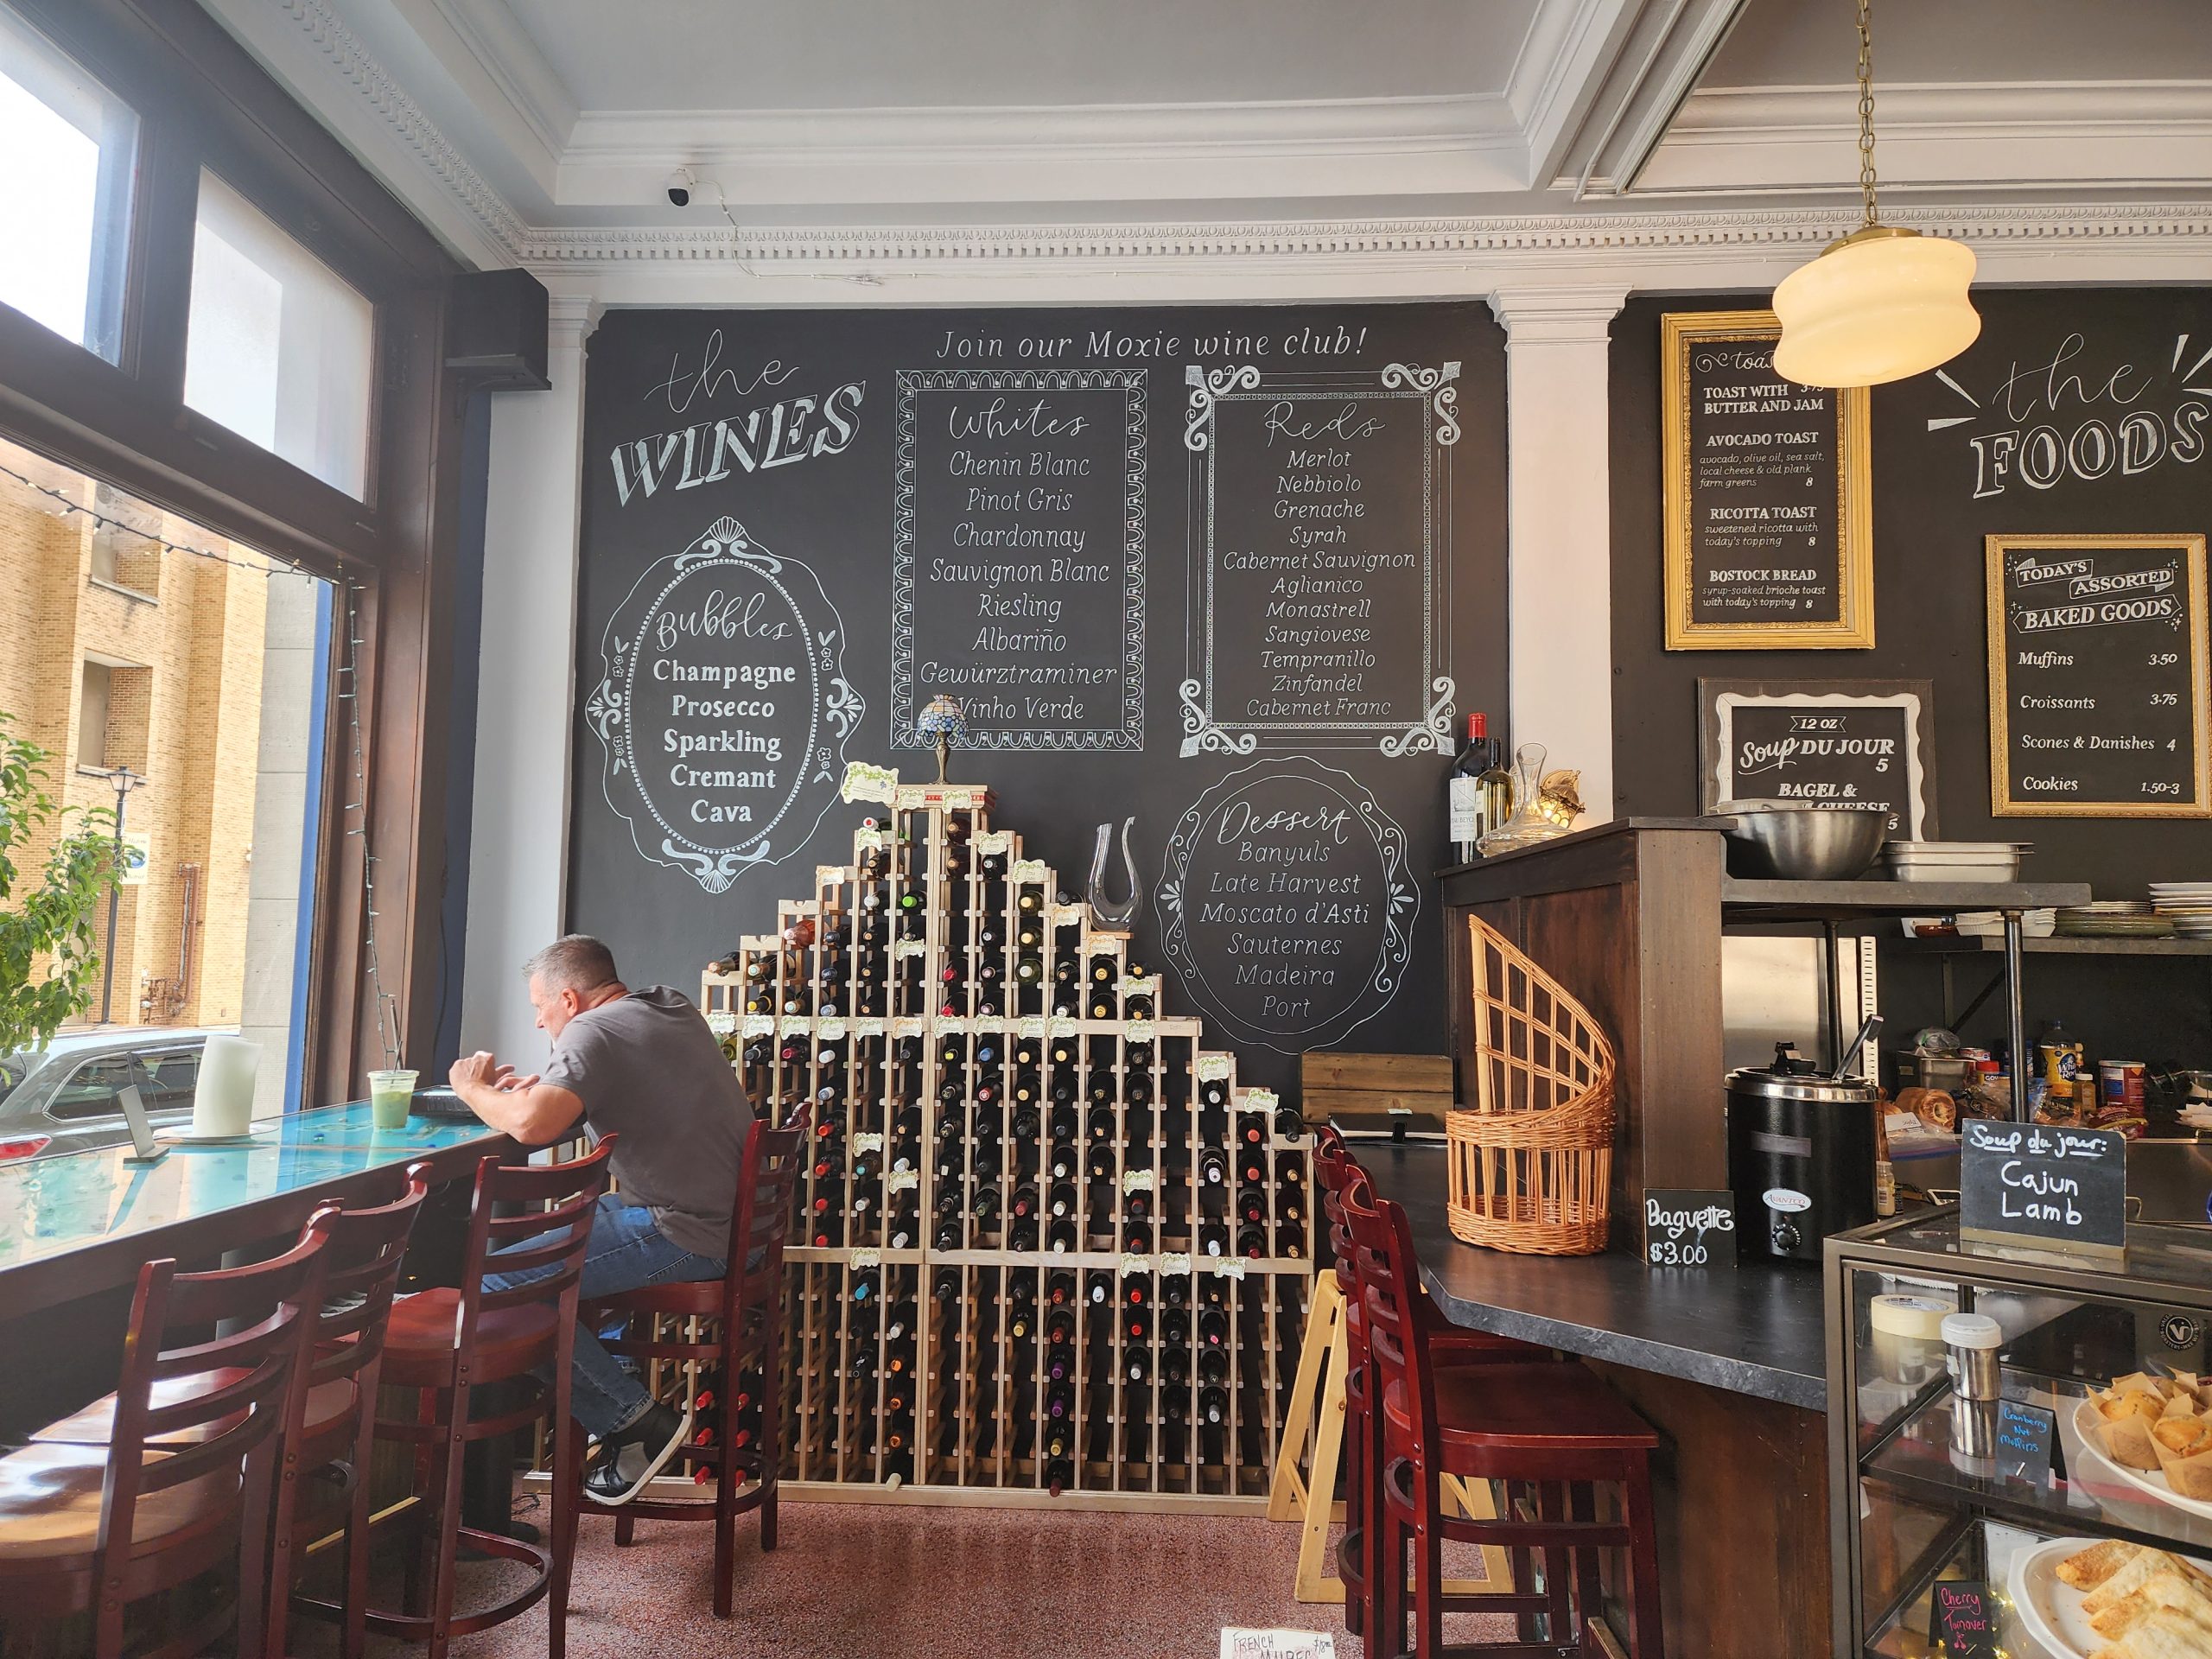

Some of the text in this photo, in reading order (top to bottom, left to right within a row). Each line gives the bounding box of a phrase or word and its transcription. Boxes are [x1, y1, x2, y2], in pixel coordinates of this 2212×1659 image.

[937, 326, 1368, 358] Join our Moxie wine club!
[644, 329, 799, 413] the
[1992, 333, 2152, 423] the
[1703, 386, 1747, 399] TOAST
[1750, 385, 1789, 397] WITH
[1704, 398, 1824, 415] BUTTER AND JAM
[950, 397, 1090, 440] Whites
[1263, 401, 1386, 448] Reds
[611, 379, 866, 507] WINES
[1706, 432, 1819, 447] AVOCADO TOAST
[1970, 401, 2209, 499] FOODS
[950, 450, 1090, 476] Chenin Blanc
[1287, 448, 1351, 469] Merlot
[1700, 454, 1742, 465] avocado,
[1744, 453, 1767, 463] olive
[1769, 453, 1783, 463] oil,
[1804, 451, 1825, 462] salt,
[1700, 463, 1812, 476] local cheese & old plank
[1276, 474, 1362, 494] Nebbiolo
[1698, 477, 1814, 489] farm greens 8
[966, 486, 1073, 512] Pinot Gris
[1274, 499, 1365, 519] Grenache
[1709, 506, 1816, 519] RICOTTA TOAST
[953, 522, 1086, 553] Chardonnay
[1289, 525, 1347, 548] Syrah
[1705, 522, 1819, 534] sweetened ricotta with
[1705, 536, 1815, 548] today's topping 8
[930, 557, 1109, 588] Sauvignon Blanc
[1224, 550, 1416, 573] Cabernet Sauvignon
[2019, 562, 2088, 582] TODAY'S
[1270, 576, 1363, 598] Aglianico
[1709, 569, 1817, 582] BOSTOCK BREAD
[2074, 570, 2171, 595] ASSORTED
[1702, 585, 1826, 596] syrup-soaked brioche toast
[977, 593, 1062, 623] Riesling
[1265, 599, 1371, 619] Monastrell
[1702, 597, 1814, 609] with today's topping 8
[2024, 599, 2172, 630] BAKED GOODS
[656, 589, 792, 652] Bubbles
[971, 626, 1066, 652] Albariño
[1265, 626, 1371, 646] Sangiovese
[1261, 650, 1376, 671] Tempranillo
[2018, 652, 2178, 669] Muffins 3.50
[653, 659, 796, 690] Champagne
[920, 661, 1117, 684] Gewürztraminer
[1272, 673, 1363, 696] Zinfandel
[671, 695, 775, 717] Prosecco
[957, 696, 1084, 720] Vinho Verde
[1247, 698, 1391, 717] Cabernet Franc
[2020, 695, 2095, 709] Croissants
[1800, 718, 1838, 729] 12 OZ
[664, 728, 782, 761] Sparkling
[1739, 737, 1895, 770] Soup DU JOUR
[2022, 734, 2176, 752] Scones & Danishes 4
[671, 764, 777, 789] Cremant
[1875, 758, 1889, 772] 5
[1777, 783, 1859, 798] BAGEL &
[2023, 777, 2180, 795] Cookies 1.50-3
[690, 799, 752, 823] Cava
[1217, 801, 1351, 845] Dessert
[1887, 817, 1898, 830] 5
[1237, 840, 1331, 867] Banyuls
[1210, 872, 1362, 894] Late Harvest
[1199, 902, 1370, 925] Moscato d'Asti
[1227, 932, 1343, 955] Sauternes
[1234, 963, 1335, 986] Madeira
[1262, 995, 1312, 1019] Port
[1969, 1124, 2022, 1154] Soup
[2027, 1128, 2053, 1149] du
[2000, 1160, 2079, 1197] Cajun
[1646, 1198, 1734, 1240] Baguette
[2001, 1192, 2082, 1225] Lamb
[1649, 1242, 1708, 1265] $3.00
[2013, 1425, 2031, 1436] Nut
[1941, 1587, 1981, 1616] Cherry
[1944, 1609, 1986, 1631] Turnover
[1233, 1630, 1274, 1654] FRENCH
